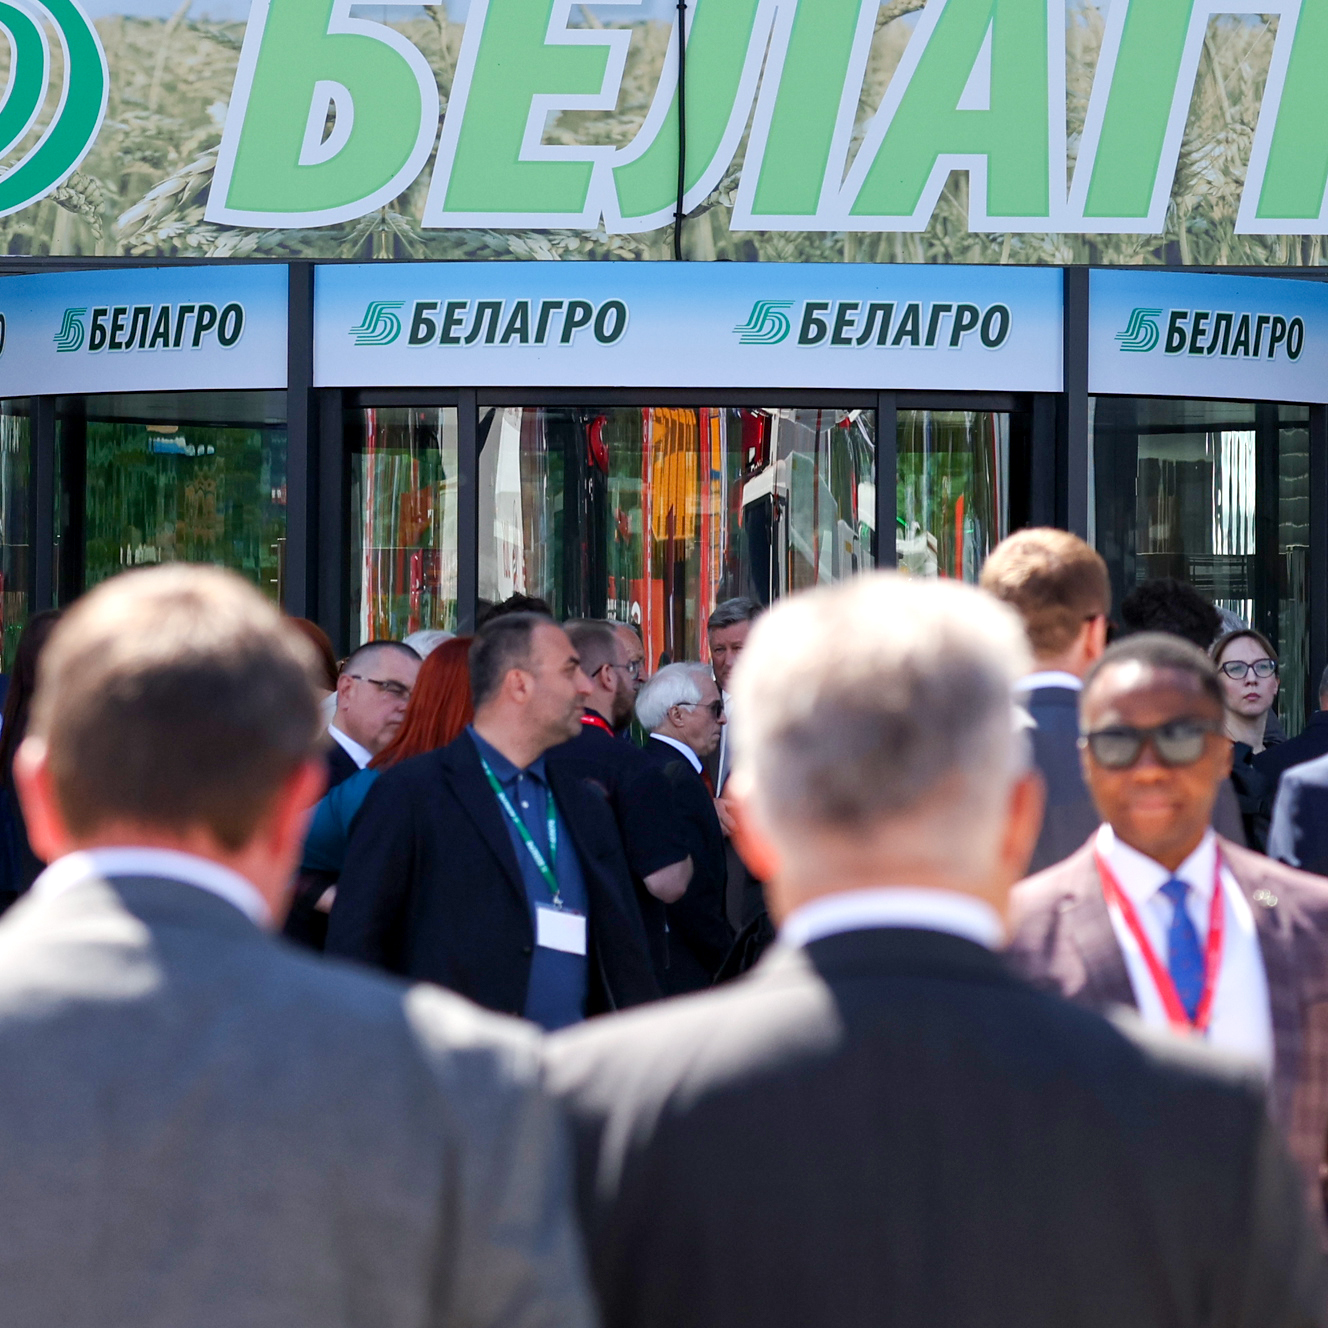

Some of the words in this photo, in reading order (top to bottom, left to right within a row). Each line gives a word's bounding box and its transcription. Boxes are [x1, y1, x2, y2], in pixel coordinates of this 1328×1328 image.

[88, 302, 244, 351] БЕЛАГРО
[408, 298, 628, 346] БЕЛАГРО
[797, 301, 1012, 349] БЕЛАГРО
[1164, 310, 1306, 362] БЕЛАГРО
